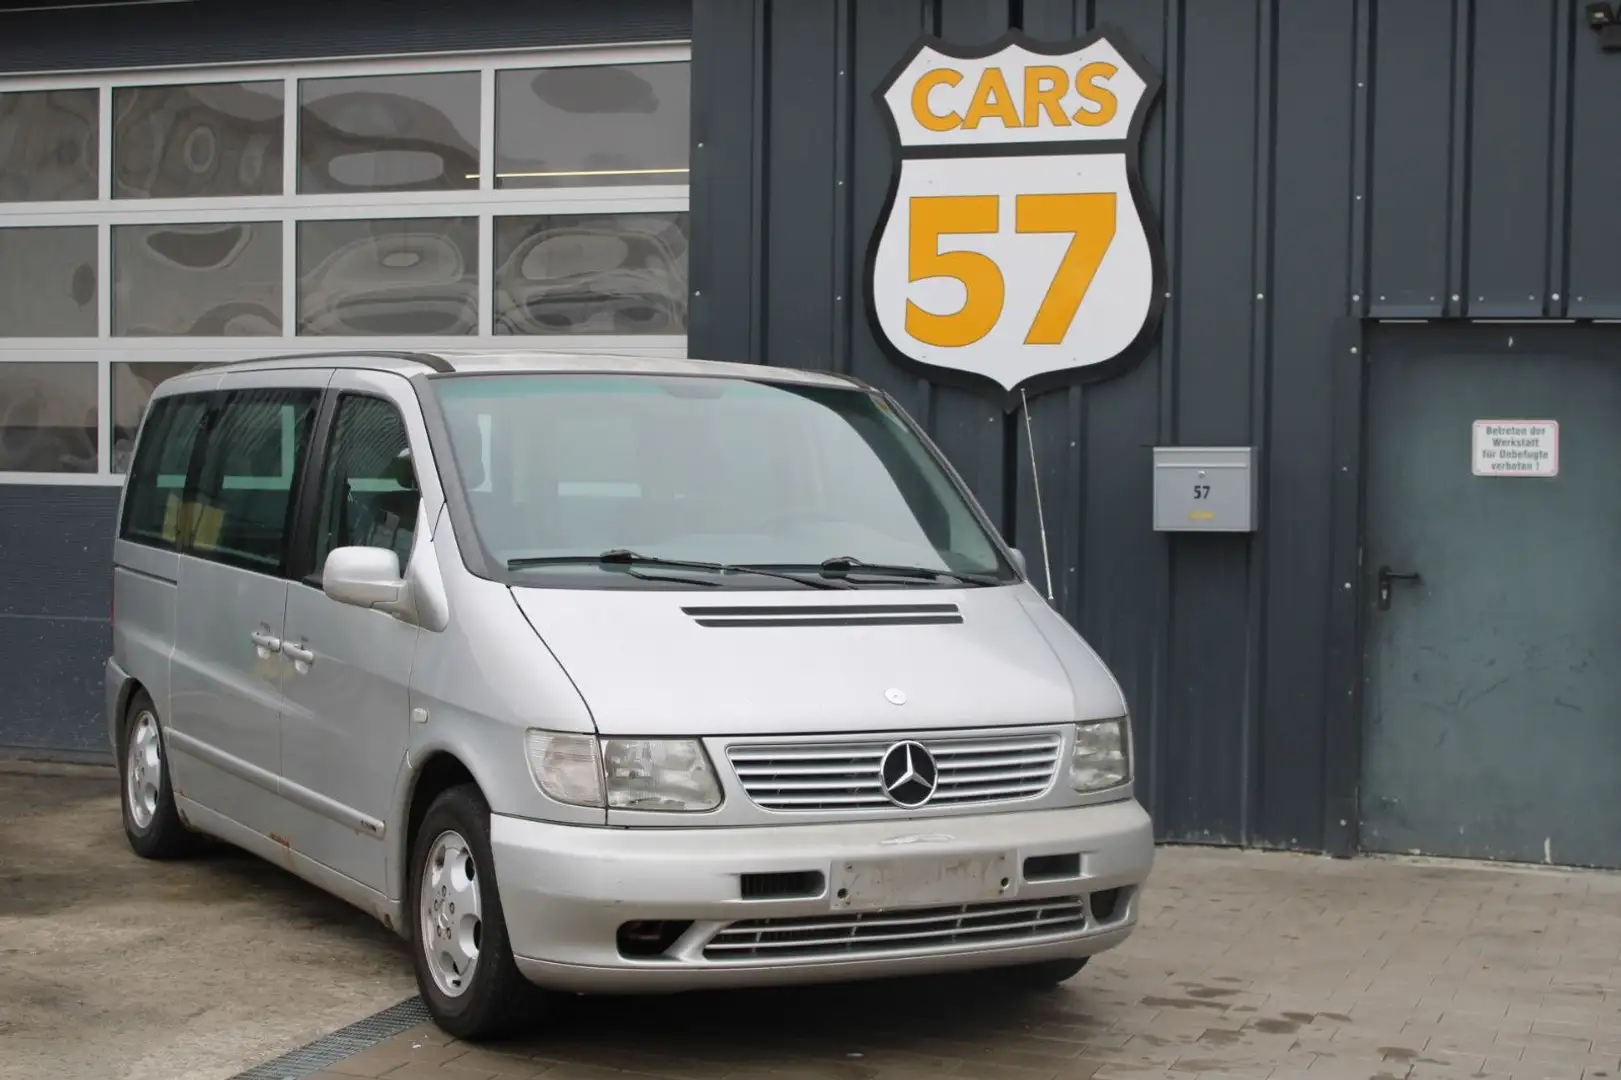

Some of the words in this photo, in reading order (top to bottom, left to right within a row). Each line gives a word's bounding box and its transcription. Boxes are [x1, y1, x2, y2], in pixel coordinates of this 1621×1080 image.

[911, 61, 1119, 131] CARS
[904, 192, 1117, 347] 57
[1486, 426, 1527, 436] Betreten
[1530, 426, 1545, 436] der
[1492, 438, 1539, 447] Werkstatt
[1500, 450, 1548, 460] Unbefugte
[1491, 462, 1532, 470] verboten
[1194, 485, 1210, 499] 57
